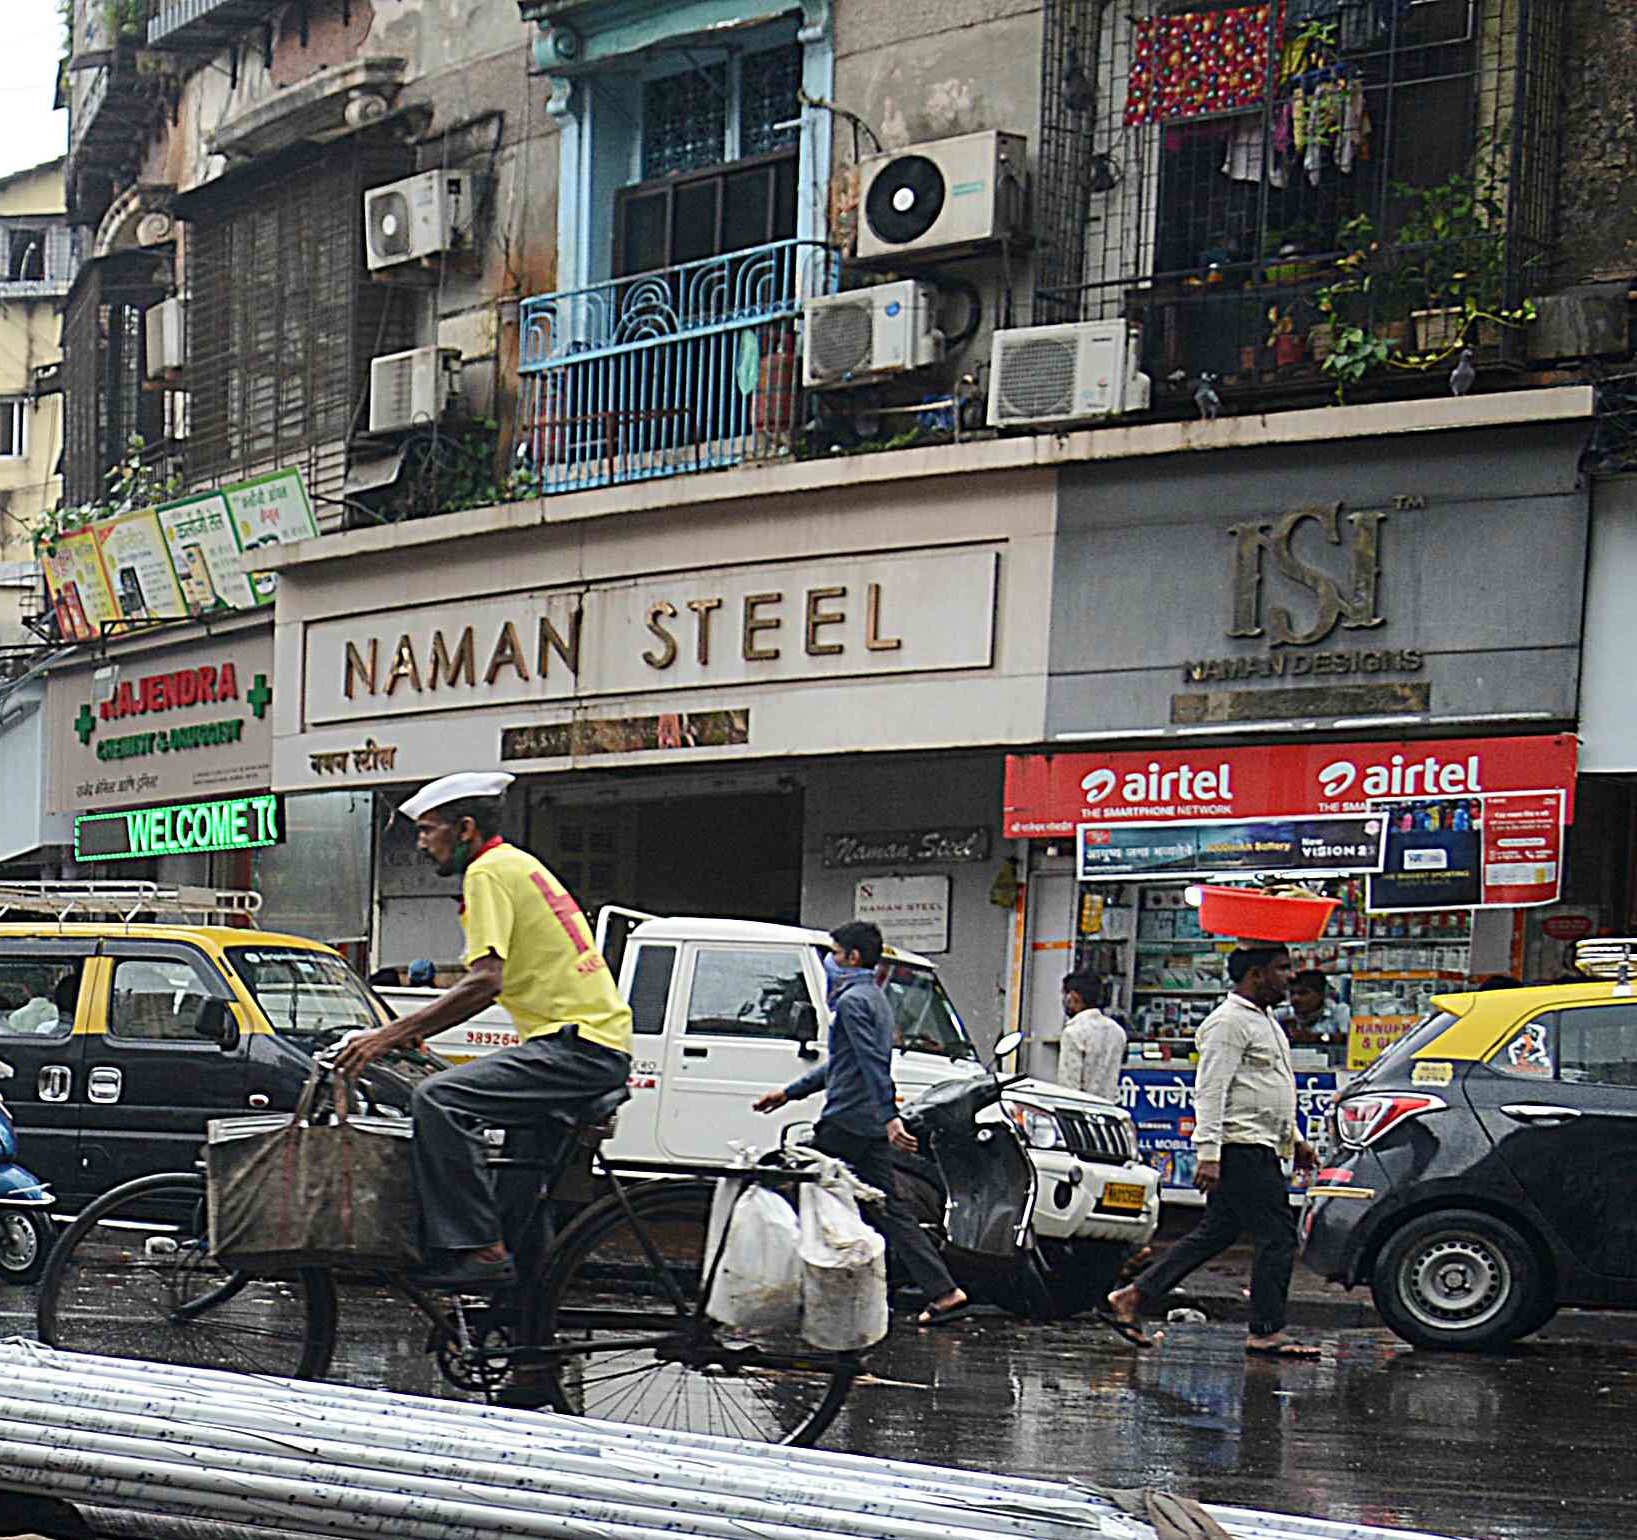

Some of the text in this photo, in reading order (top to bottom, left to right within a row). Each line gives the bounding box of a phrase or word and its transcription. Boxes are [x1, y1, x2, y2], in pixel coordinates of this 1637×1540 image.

[343, 582, 903, 699] NAMAN STEEL
[1183, 648, 1425, 684] NAMAN DESIGNS
[96, 731, 156, 762] CHEMIST
[169, 718, 245, 752] DRUGGIST
[1121, 761, 1234, 802] airtel
[1361, 754, 1482, 796] airtel
[126, 800, 250, 853] WELCOME
[1081, 804, 1233, 819] THE SMARTPHONE NETWORK
[1318, 802, 1340, 813] THE
[1301, 845, 1356, 857] VISION
[859, 904, 902, 913] NAMAN
